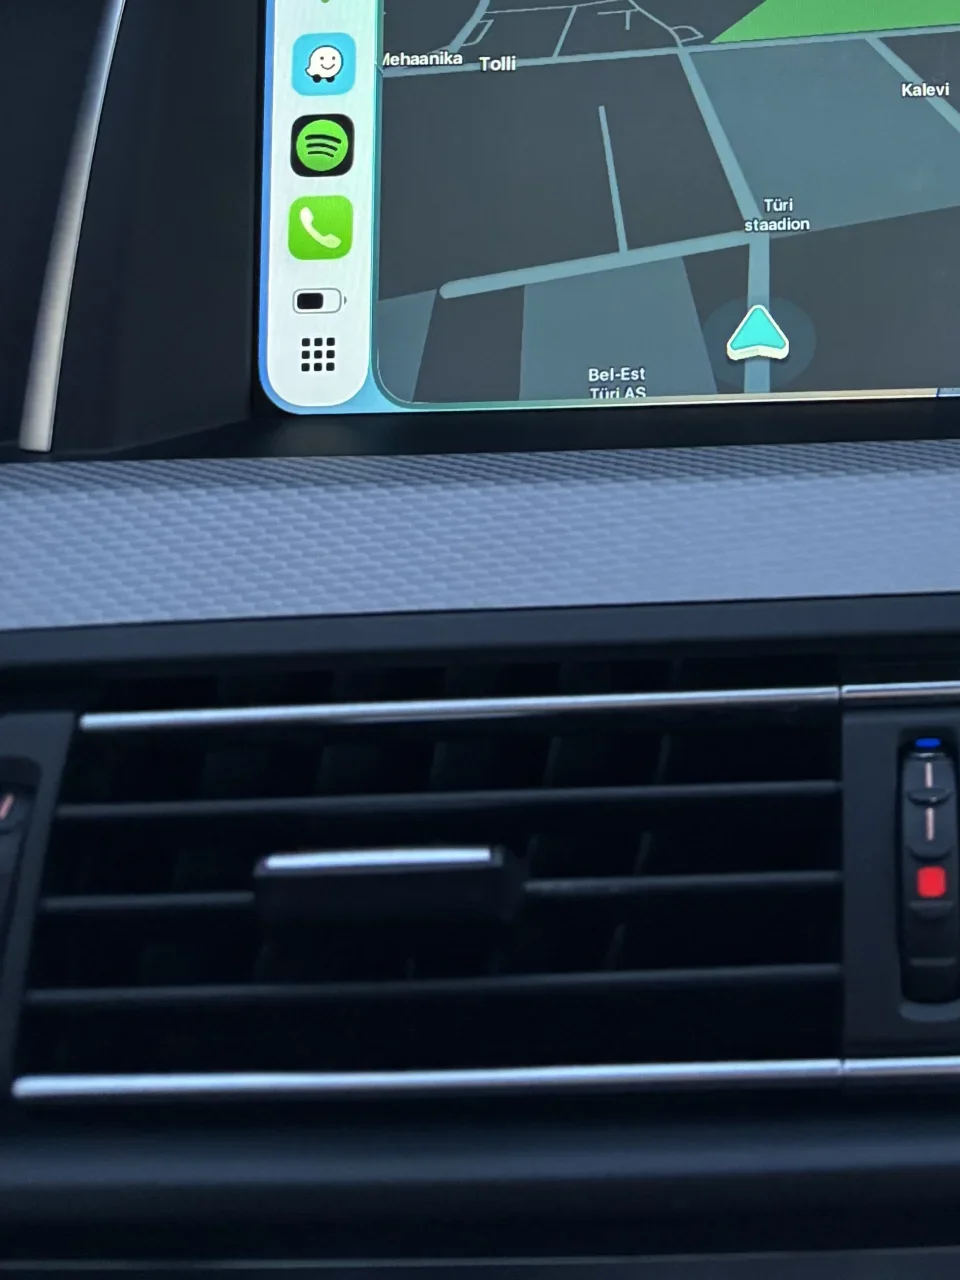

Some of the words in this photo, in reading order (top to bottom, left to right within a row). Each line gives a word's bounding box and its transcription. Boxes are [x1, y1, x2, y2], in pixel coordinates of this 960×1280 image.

[478, 55, 517, 72] Tolli
[901, 81, 950, 97] Kalevi
[763, 197, 794, 212] Türi
[744, 216, 811, 232] staadion
[588, 366, 646, 382] Bel-Est
[589, 387, 620, 400] Türi
[624, 386, 647, 399] AS
